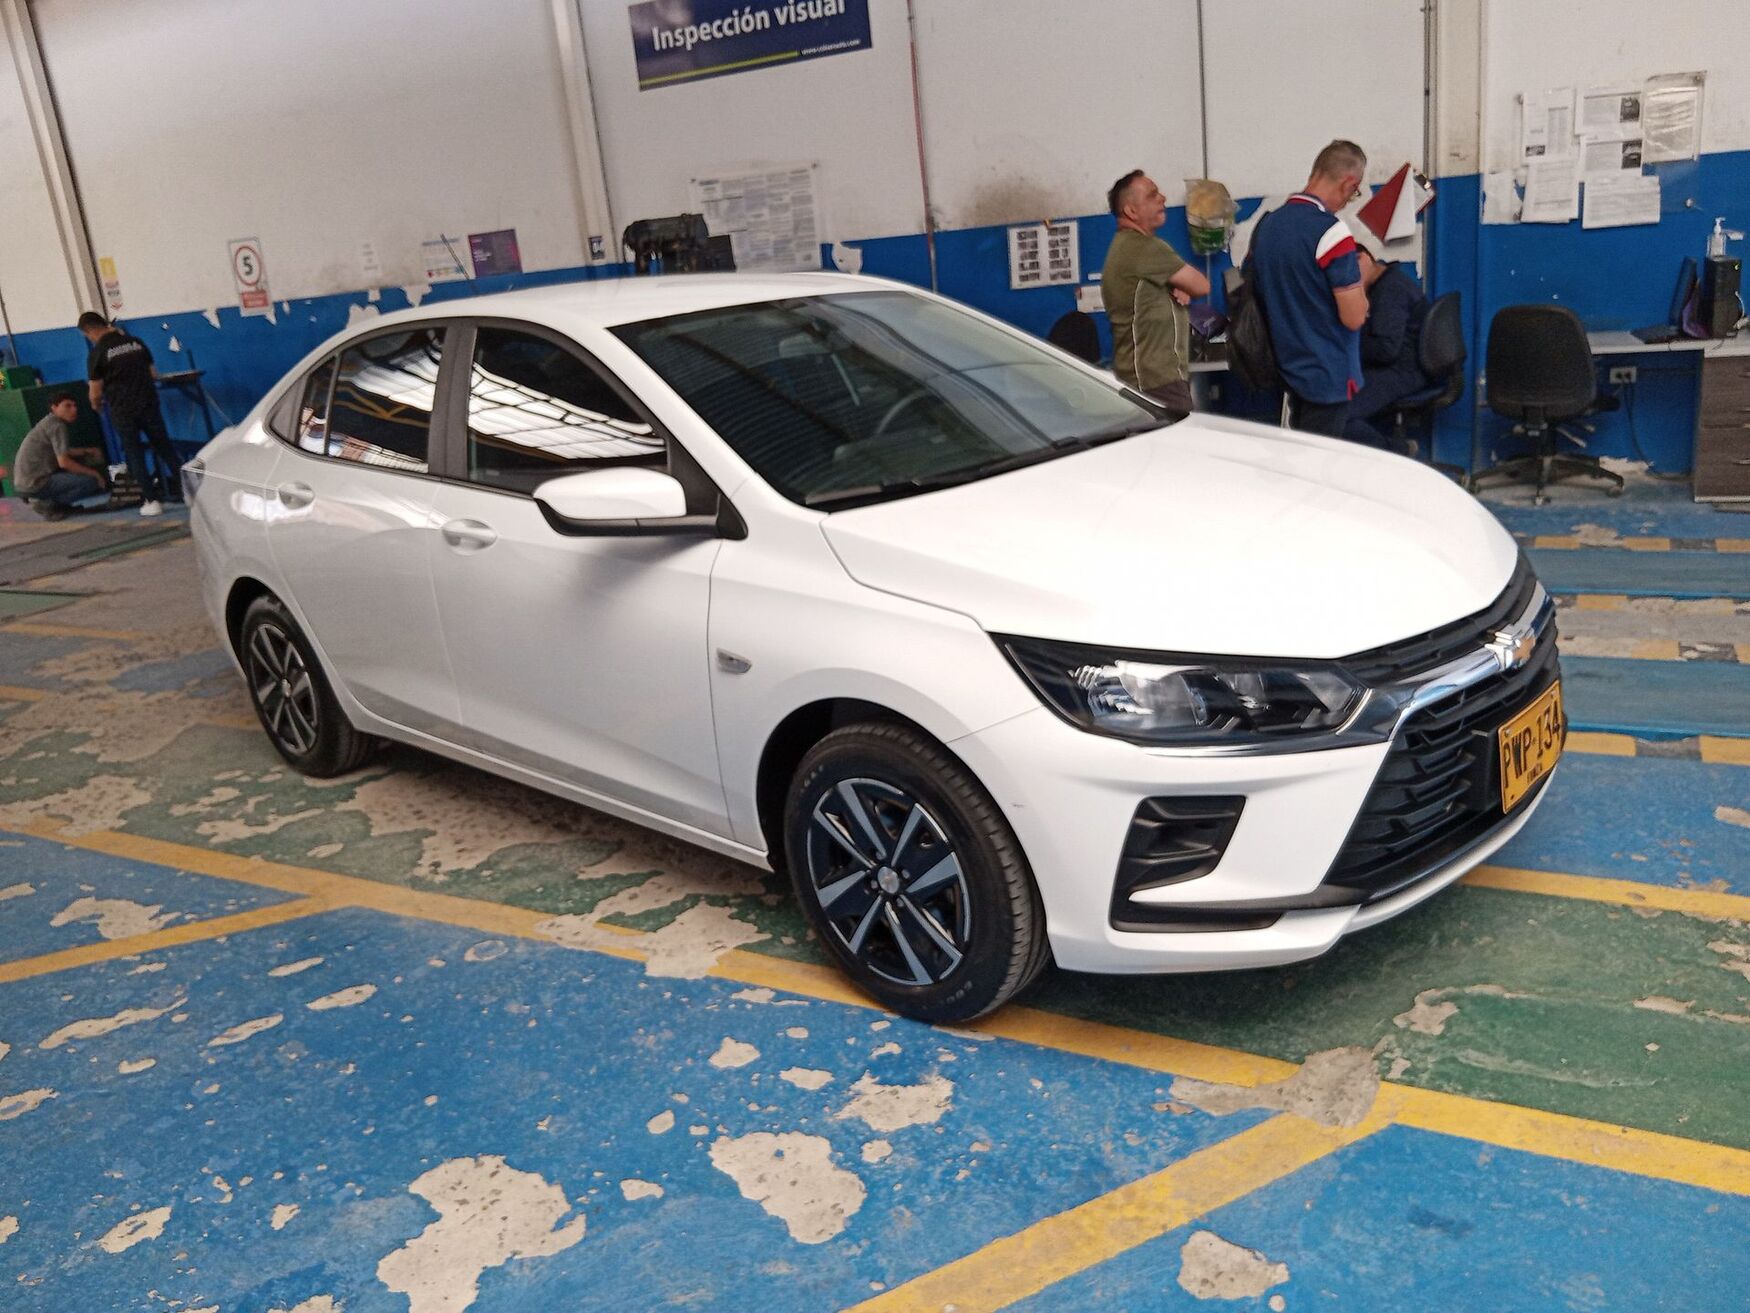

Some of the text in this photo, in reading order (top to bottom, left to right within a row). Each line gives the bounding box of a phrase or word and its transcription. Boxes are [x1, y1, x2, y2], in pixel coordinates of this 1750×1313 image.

[652, 0, 845, 51] Inspección visual
[243, 256, 253, 276] 5
